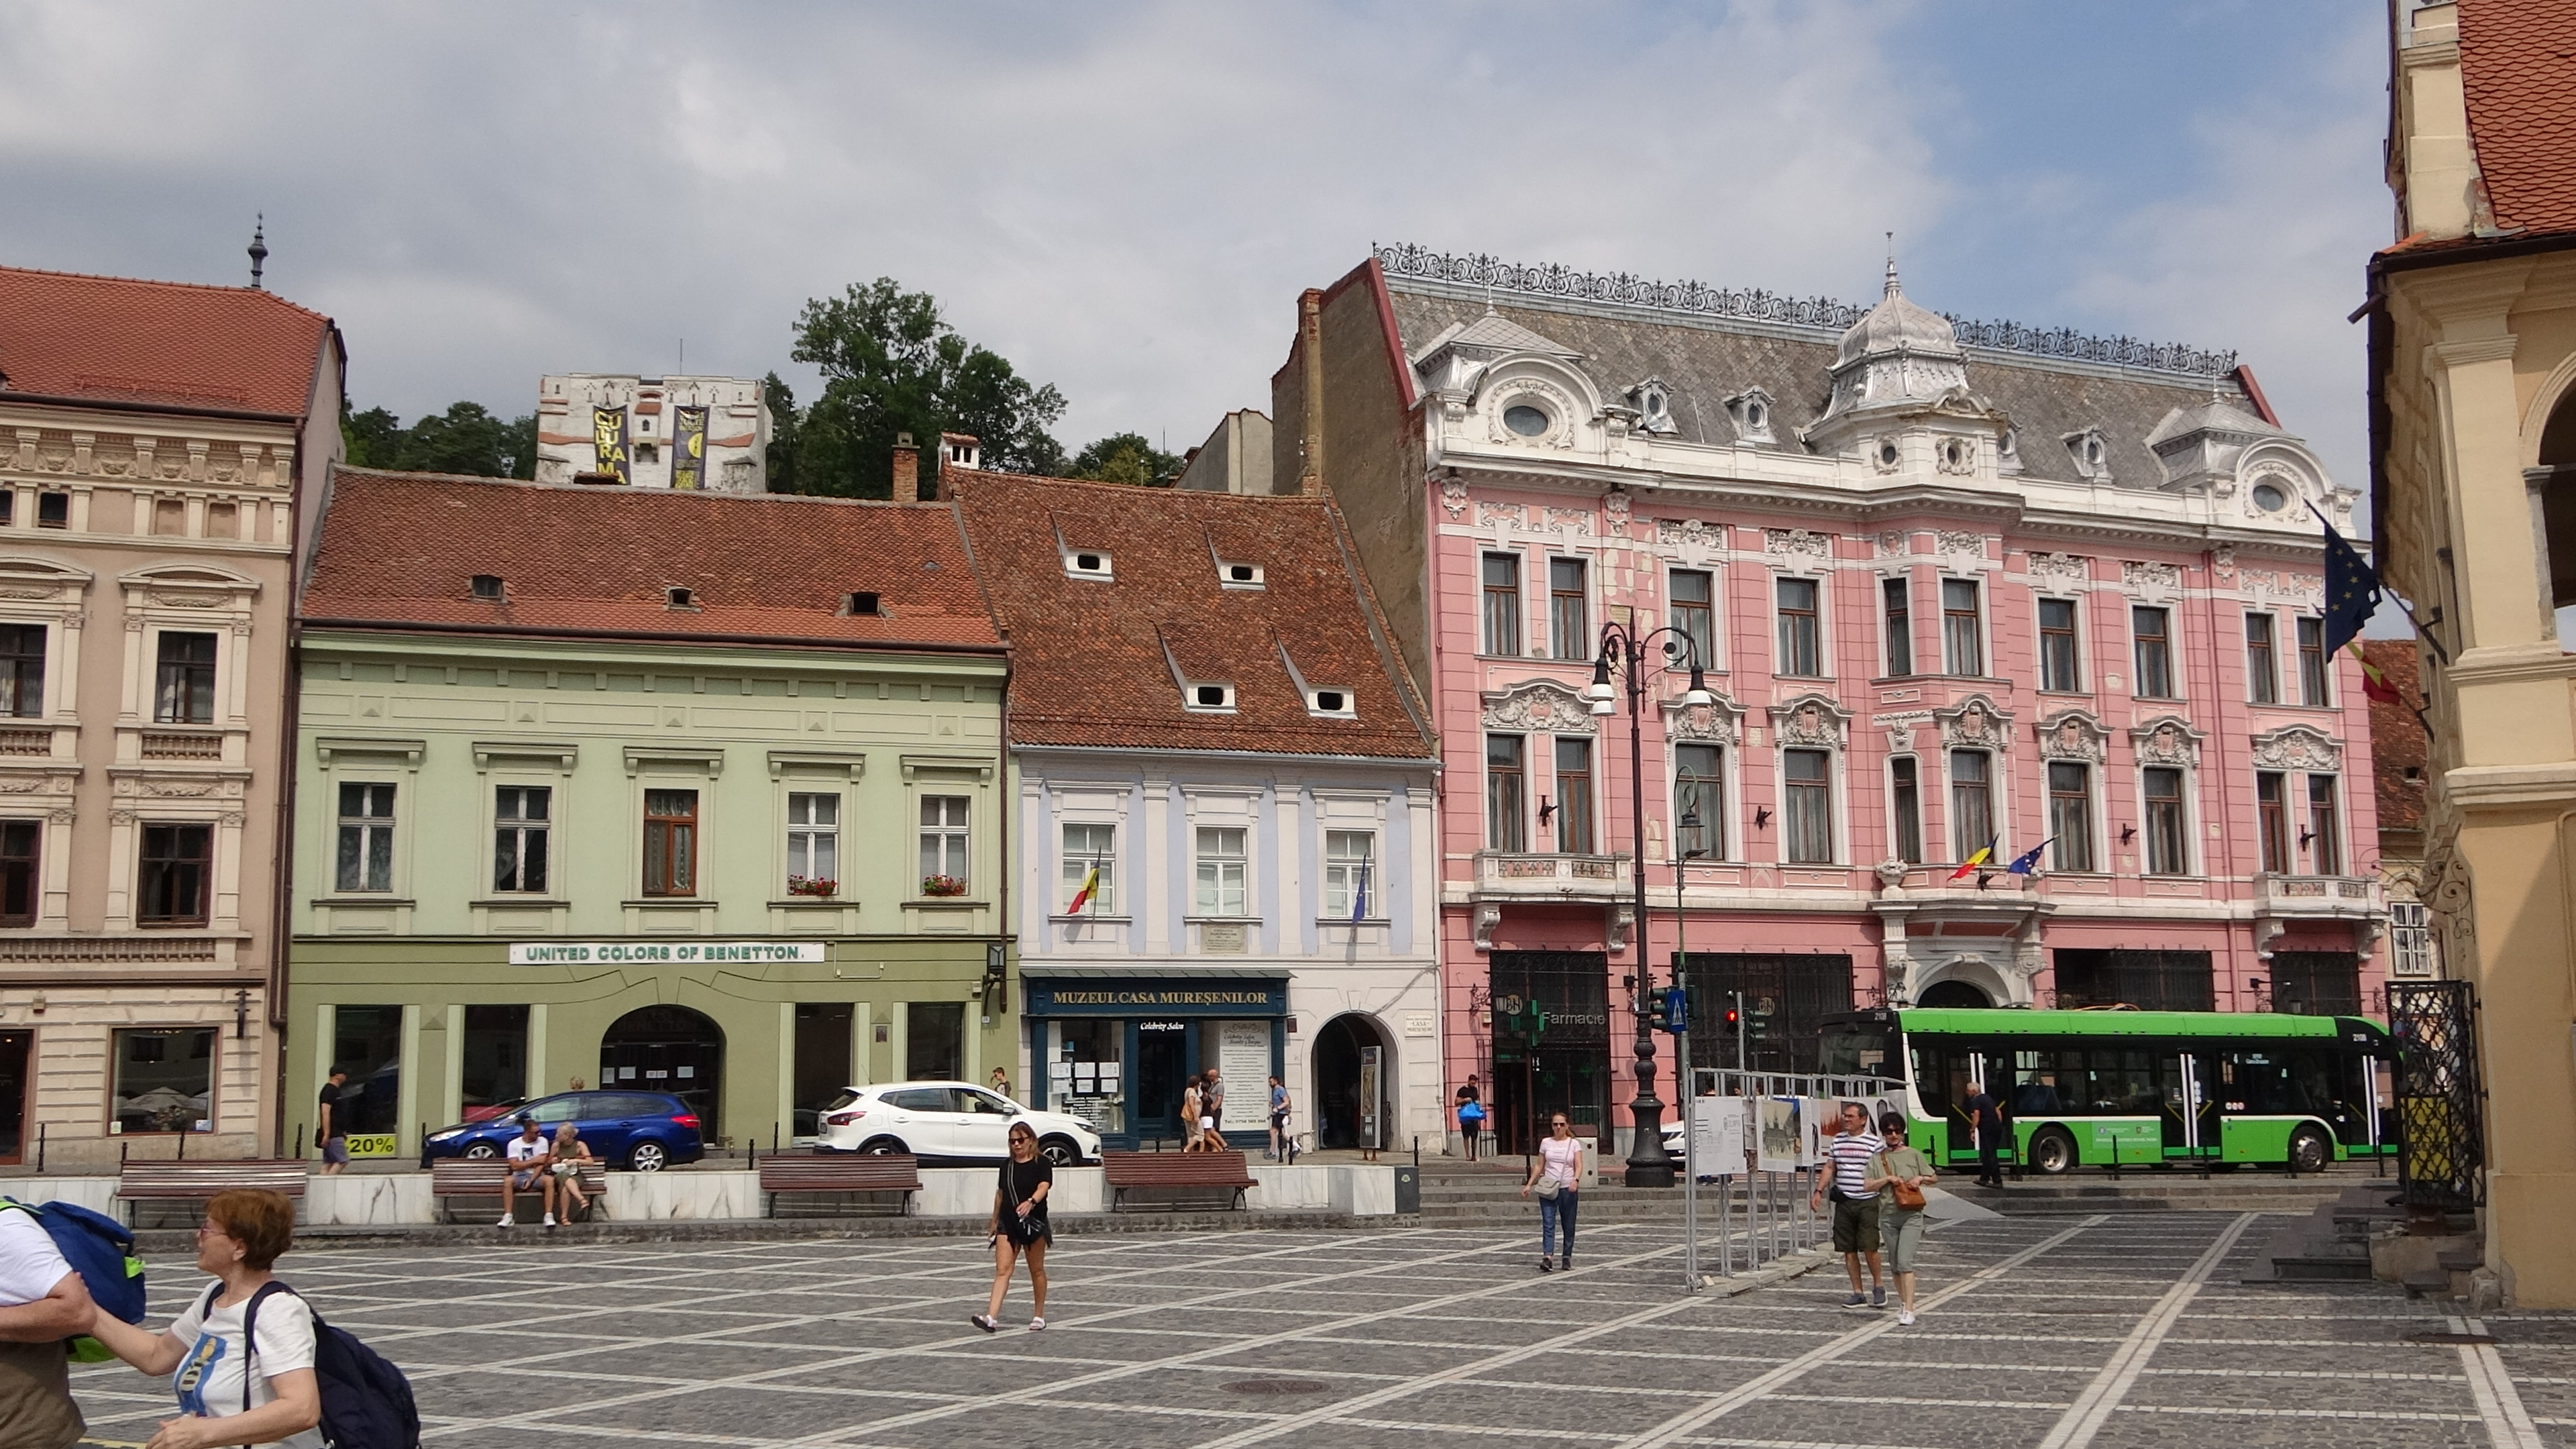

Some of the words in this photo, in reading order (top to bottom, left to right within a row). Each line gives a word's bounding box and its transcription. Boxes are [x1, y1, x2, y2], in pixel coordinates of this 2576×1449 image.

[526, 947, 590, 961] UNITED
[597, 946, 669, 960] COLORS
[677, 947, 698, 959] OF
[1053, 991, 1118, 1004] MUZEUL
[1118, 991, 1157, 1004] CASA
[1159, 991, 1268, 1006] MUREȘENILOR
[1542, 1012, 1605, 1025] Farmacie
[1140, 1022, 1167, 1032] Celebrity
[1167, 1022, 1185, 1031] Salon
